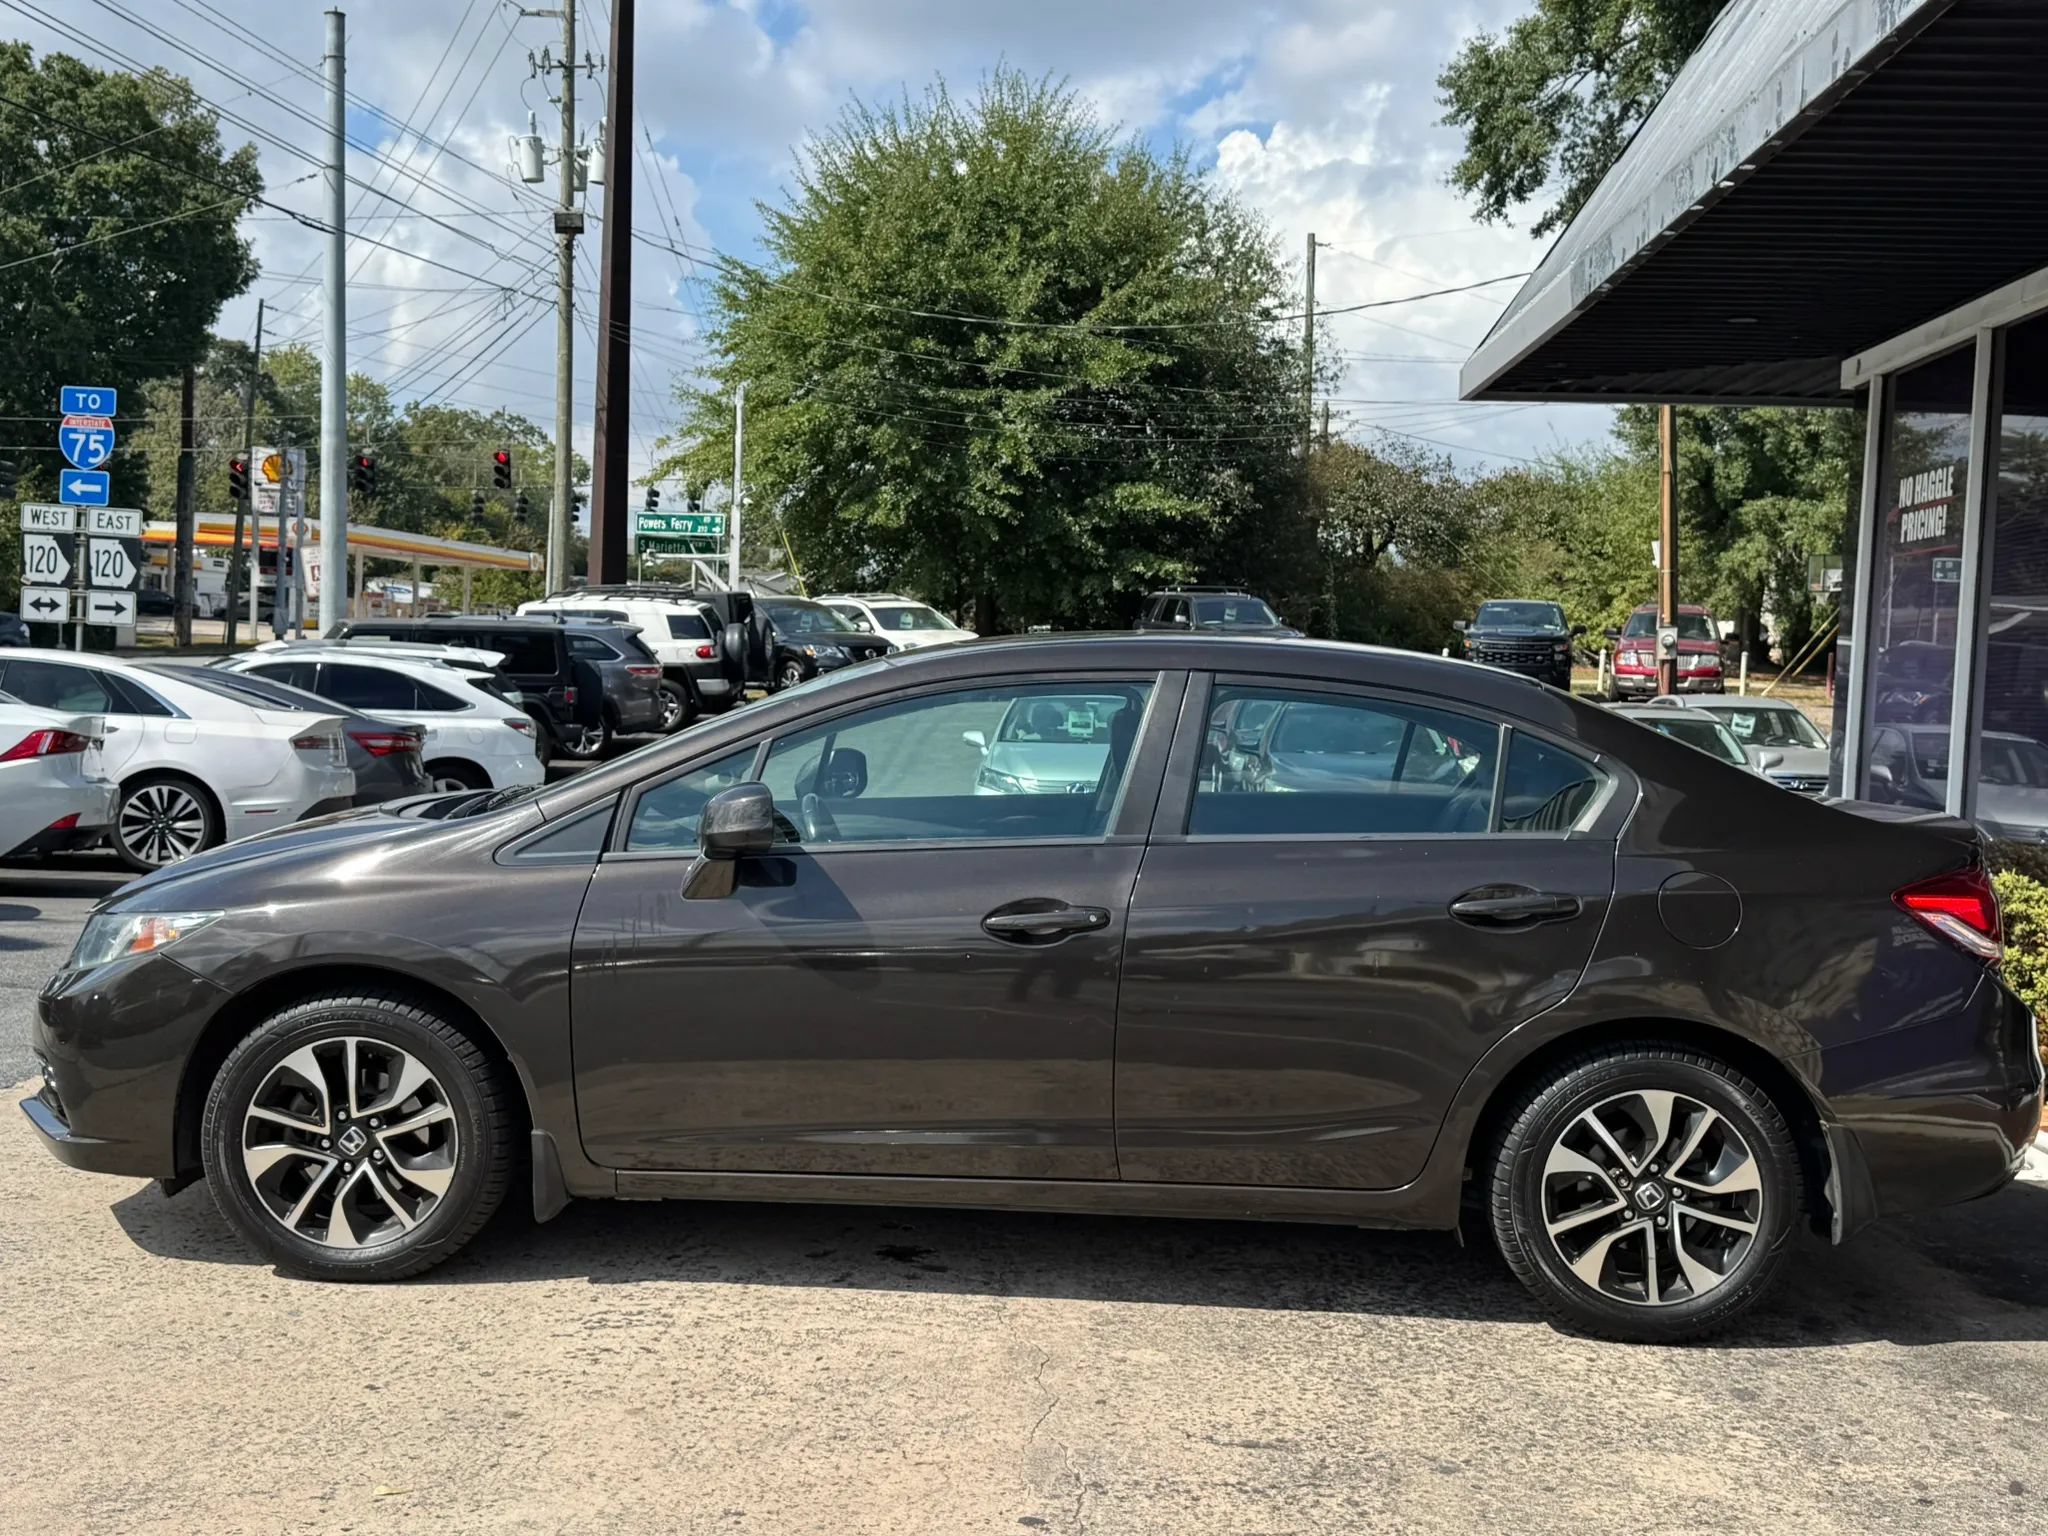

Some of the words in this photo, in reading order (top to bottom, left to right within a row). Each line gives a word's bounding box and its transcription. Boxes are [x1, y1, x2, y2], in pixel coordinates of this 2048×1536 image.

[75, 393, 101, 409] TO
[69, 433, 105, 464] 75
[1899, 476, 1913, 508] NO
[1914, 466, 1954, 504] HAGGLE
[31, 509, 67, 526] WEST
[97, 513, 133, 530] EAST
[639, 517, 666, 529] Powers
[671, 517, 693, 533] Ferry
[1900, 504, 1947, 544] PRICING!
[29, 545, 58, 574] 120
[95, 549, 123, 578] 120
